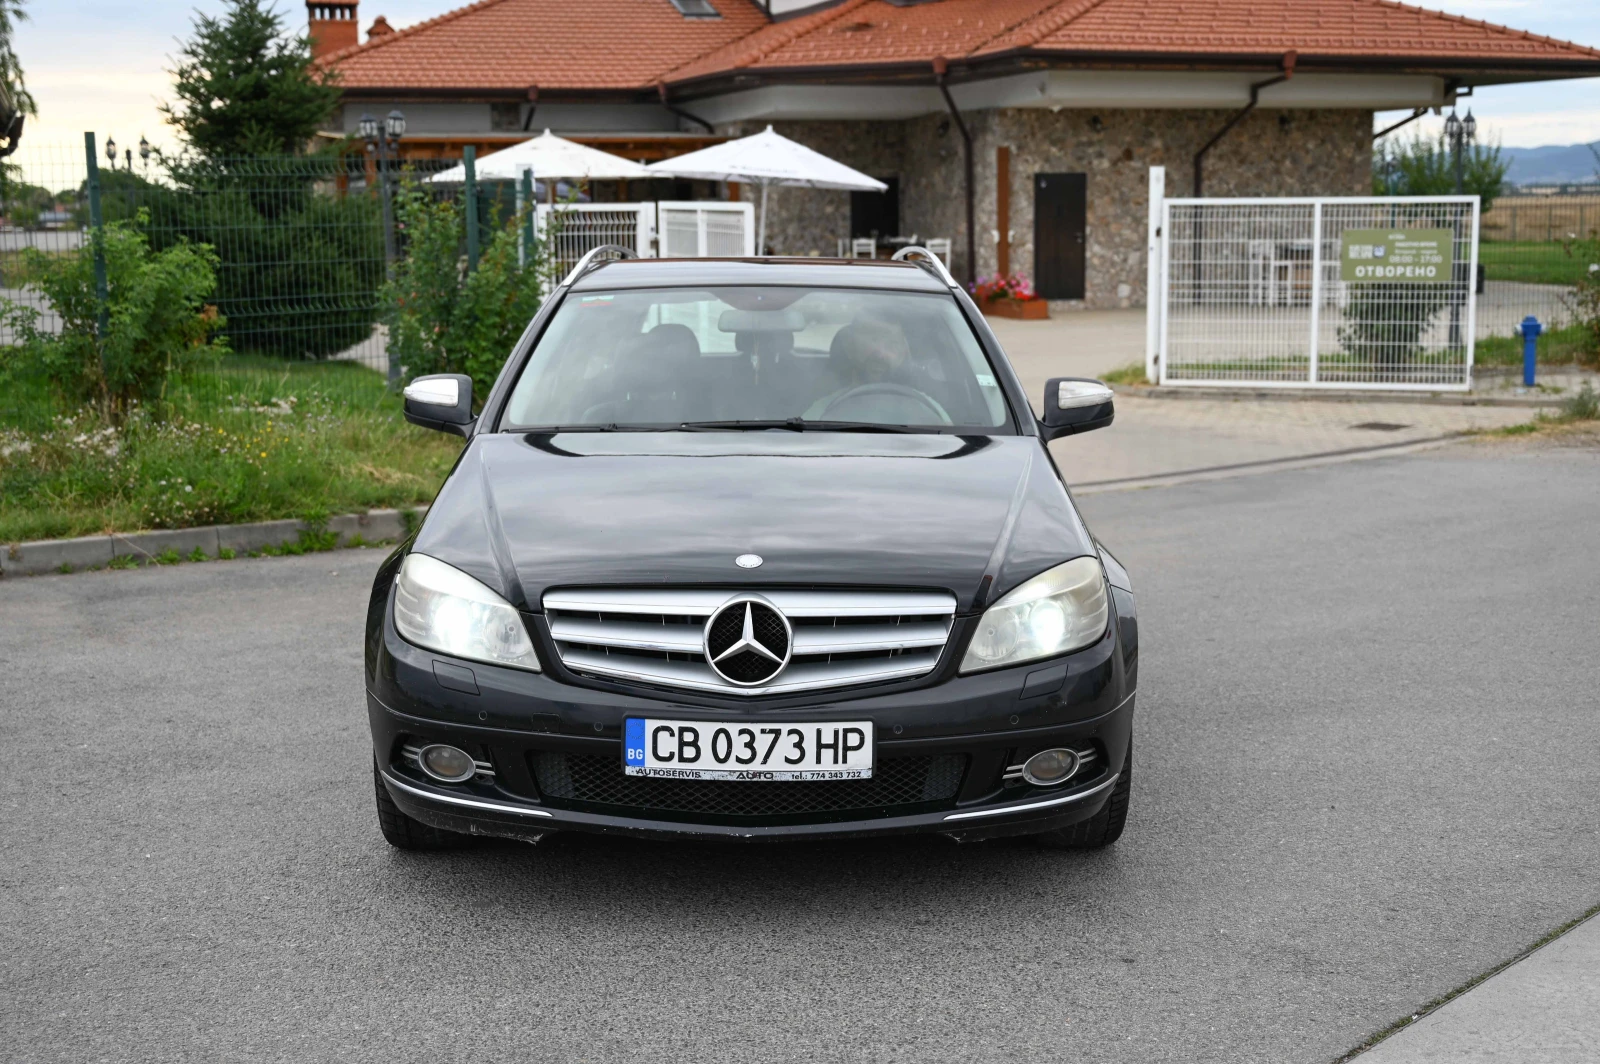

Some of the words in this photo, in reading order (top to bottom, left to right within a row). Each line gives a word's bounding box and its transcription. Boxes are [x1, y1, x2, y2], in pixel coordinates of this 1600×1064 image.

[1355, 265, 1436, 277] ОТВОРЕНО
[651, 725, 702, 763] CB
[711, 727, 806, 765] 0373
[815, 727, 865, 765] HP
[627, 748, 644, 760] BG
[636, 768, 702, 779] AUTOSERVIS
[810, 772, 826, 780] 774
